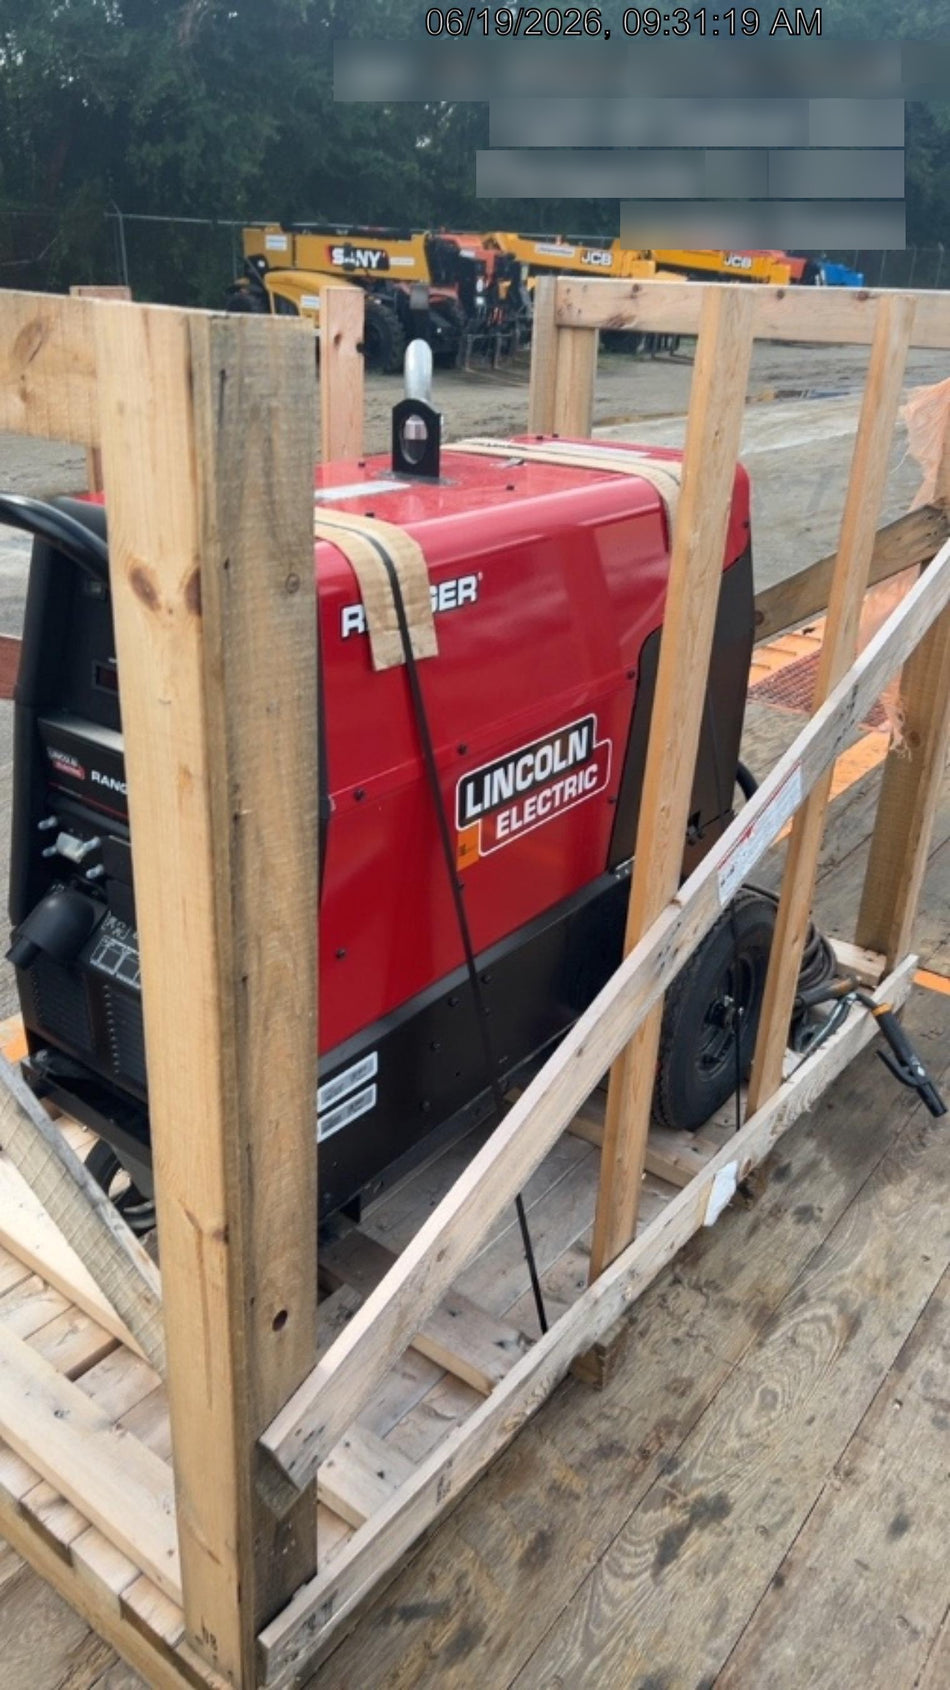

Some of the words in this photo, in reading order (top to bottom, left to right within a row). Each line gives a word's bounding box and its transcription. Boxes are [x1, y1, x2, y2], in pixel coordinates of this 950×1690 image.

[581, 250, 612, 266] JCB
[724, 253, 752, 268] JCB
[465, 726, 589, 819] LINCOLN
[495, 763, 598, 840] ELECTRIC
